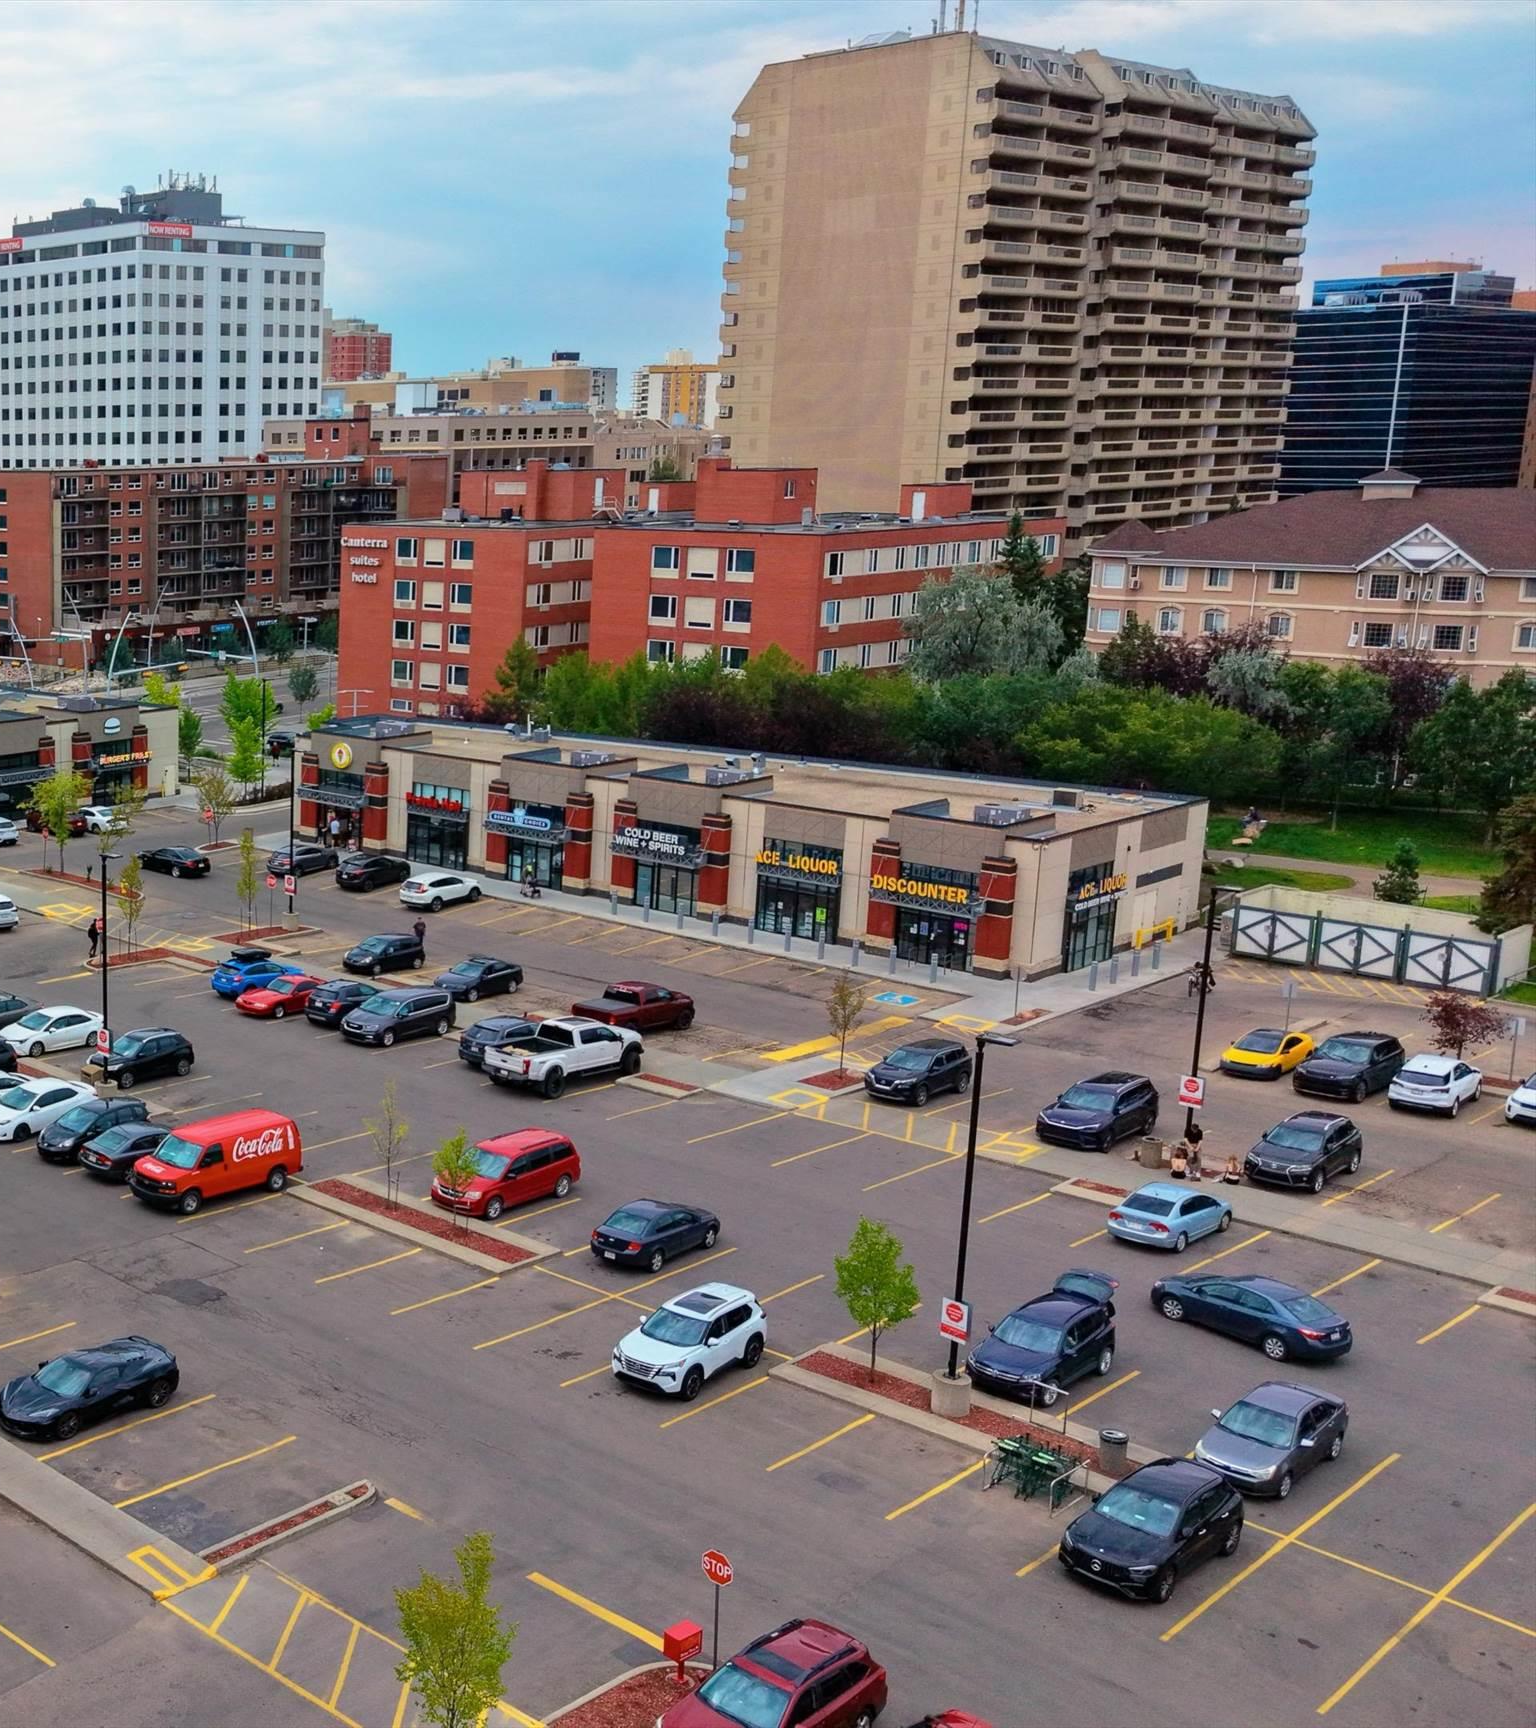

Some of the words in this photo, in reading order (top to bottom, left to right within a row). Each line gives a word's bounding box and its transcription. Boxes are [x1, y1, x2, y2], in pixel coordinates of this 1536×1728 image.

[340, 536, 388, 549] Canterra
[349, 555, 380, 567] suites
[351, 571, 377, 584] hotel
[615, 835, 639, 848] WINE
[640, 840, 647, 848] +
[648, 841, 685, 856] SPIRITS
[624, 827, 651, 840] COLD
[652, 832, 679, 845] BEER
[754, 850, 781, 866] ACE
[789, 854, 838, 876] LIQUOR
[872, 873, 968, 905] DISCOUNTER
[1078, 881, 1097, 900] ACE
[1099, 872, 1127, 894] LIQUOR
[703, 1556, 733, 1579] STOP
